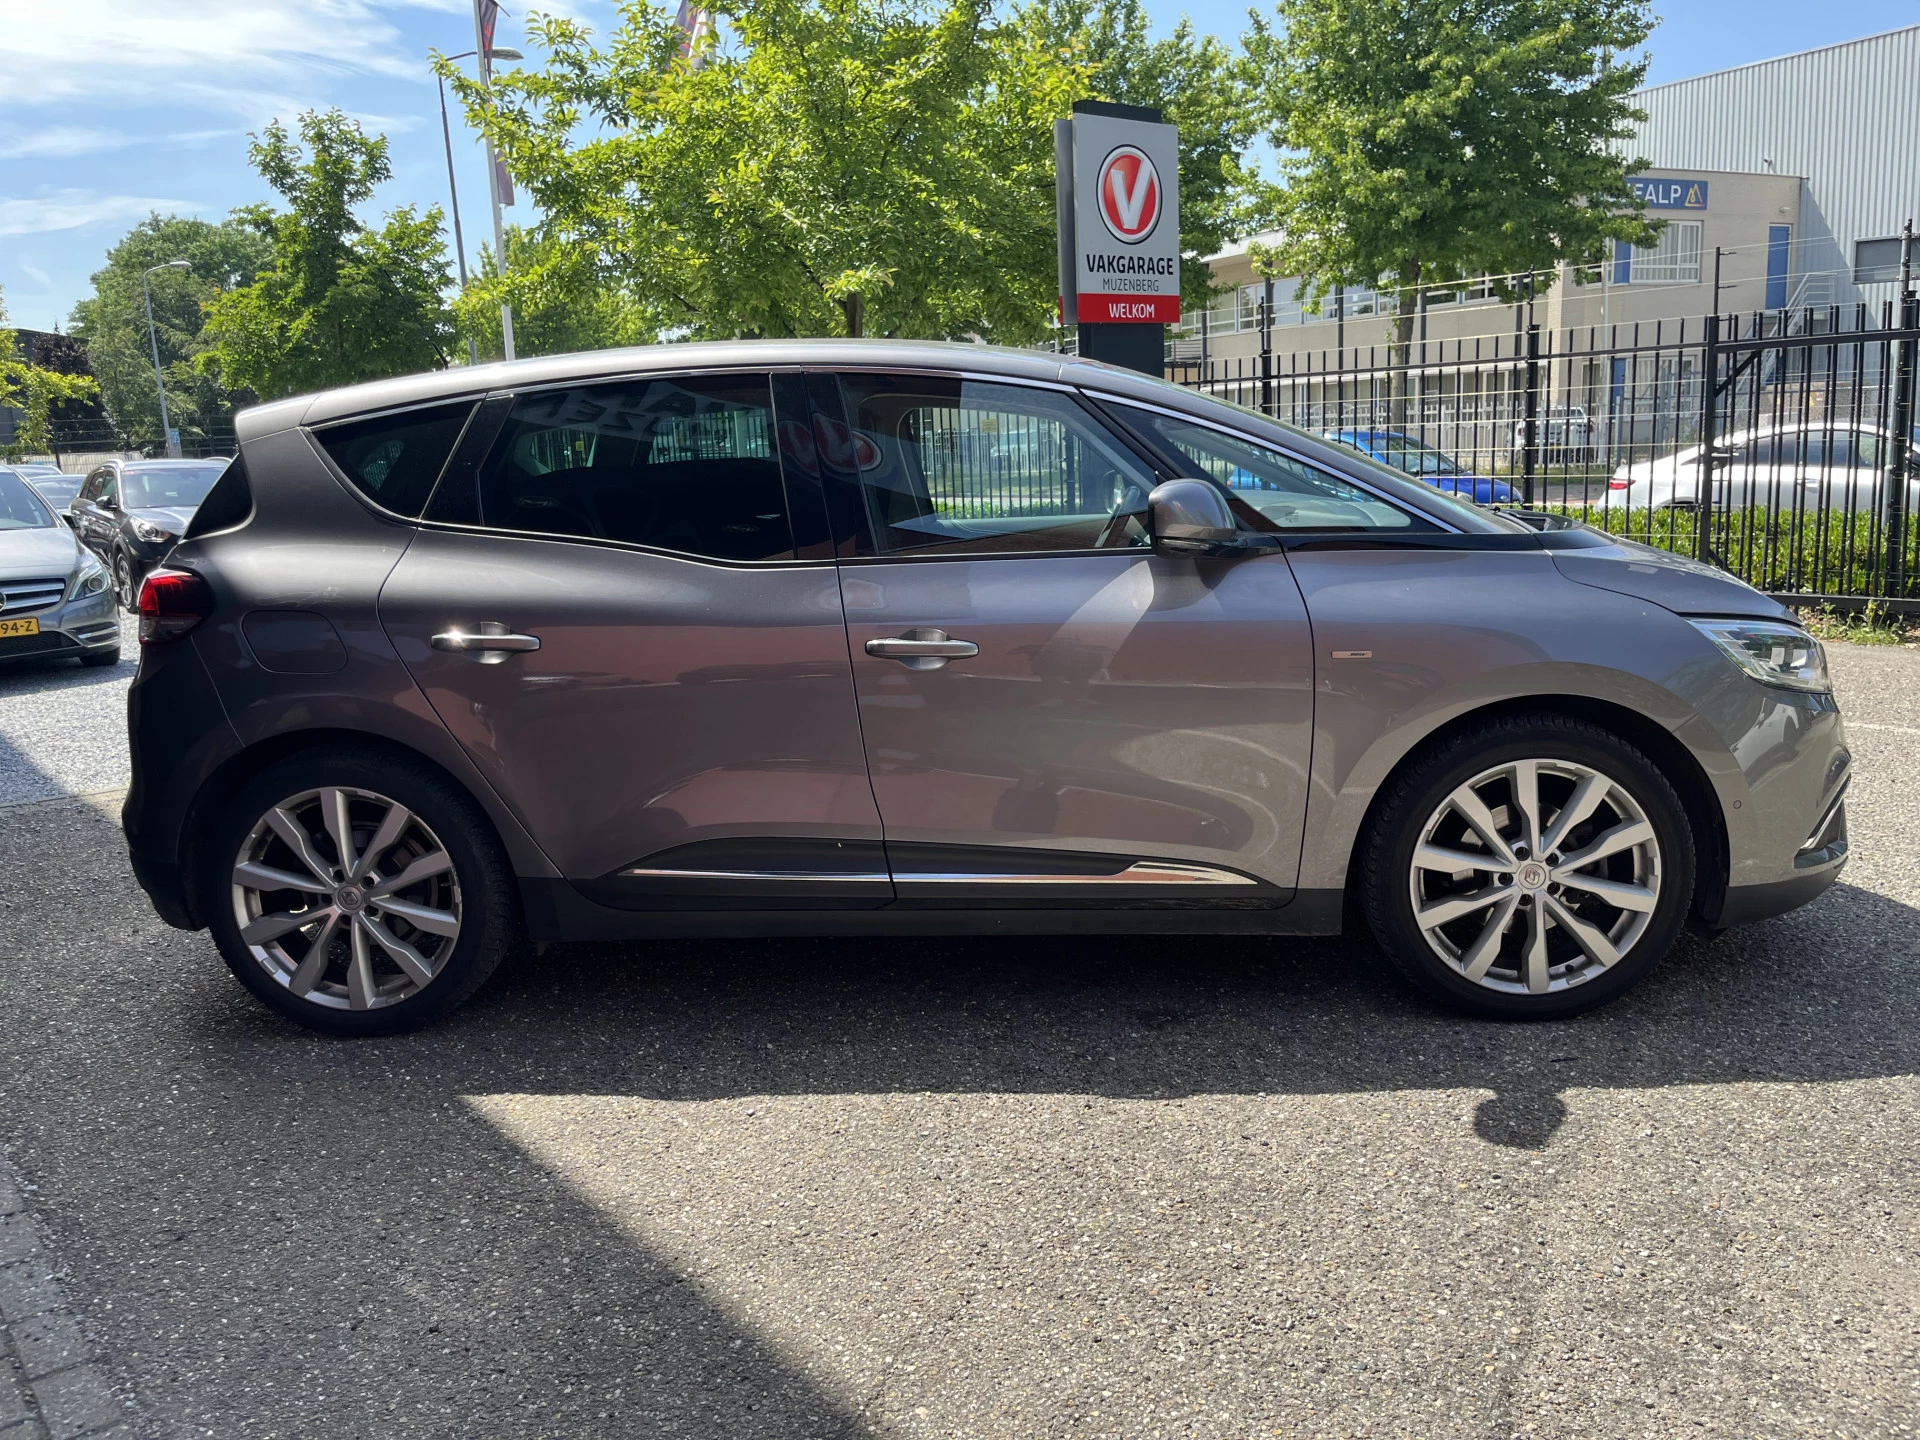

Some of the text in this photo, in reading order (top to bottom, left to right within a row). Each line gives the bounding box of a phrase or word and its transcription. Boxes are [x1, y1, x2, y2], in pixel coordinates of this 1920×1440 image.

[1608, 183, 1682, 204] FALP
[1086, 253, 1174, 275] VAKGARAGE
[1102, 278, 1159, 292] MUZENBERG
[1108, 303, 1155, 318] WELKOM
[0, 620, 34, 634] 94-Z
